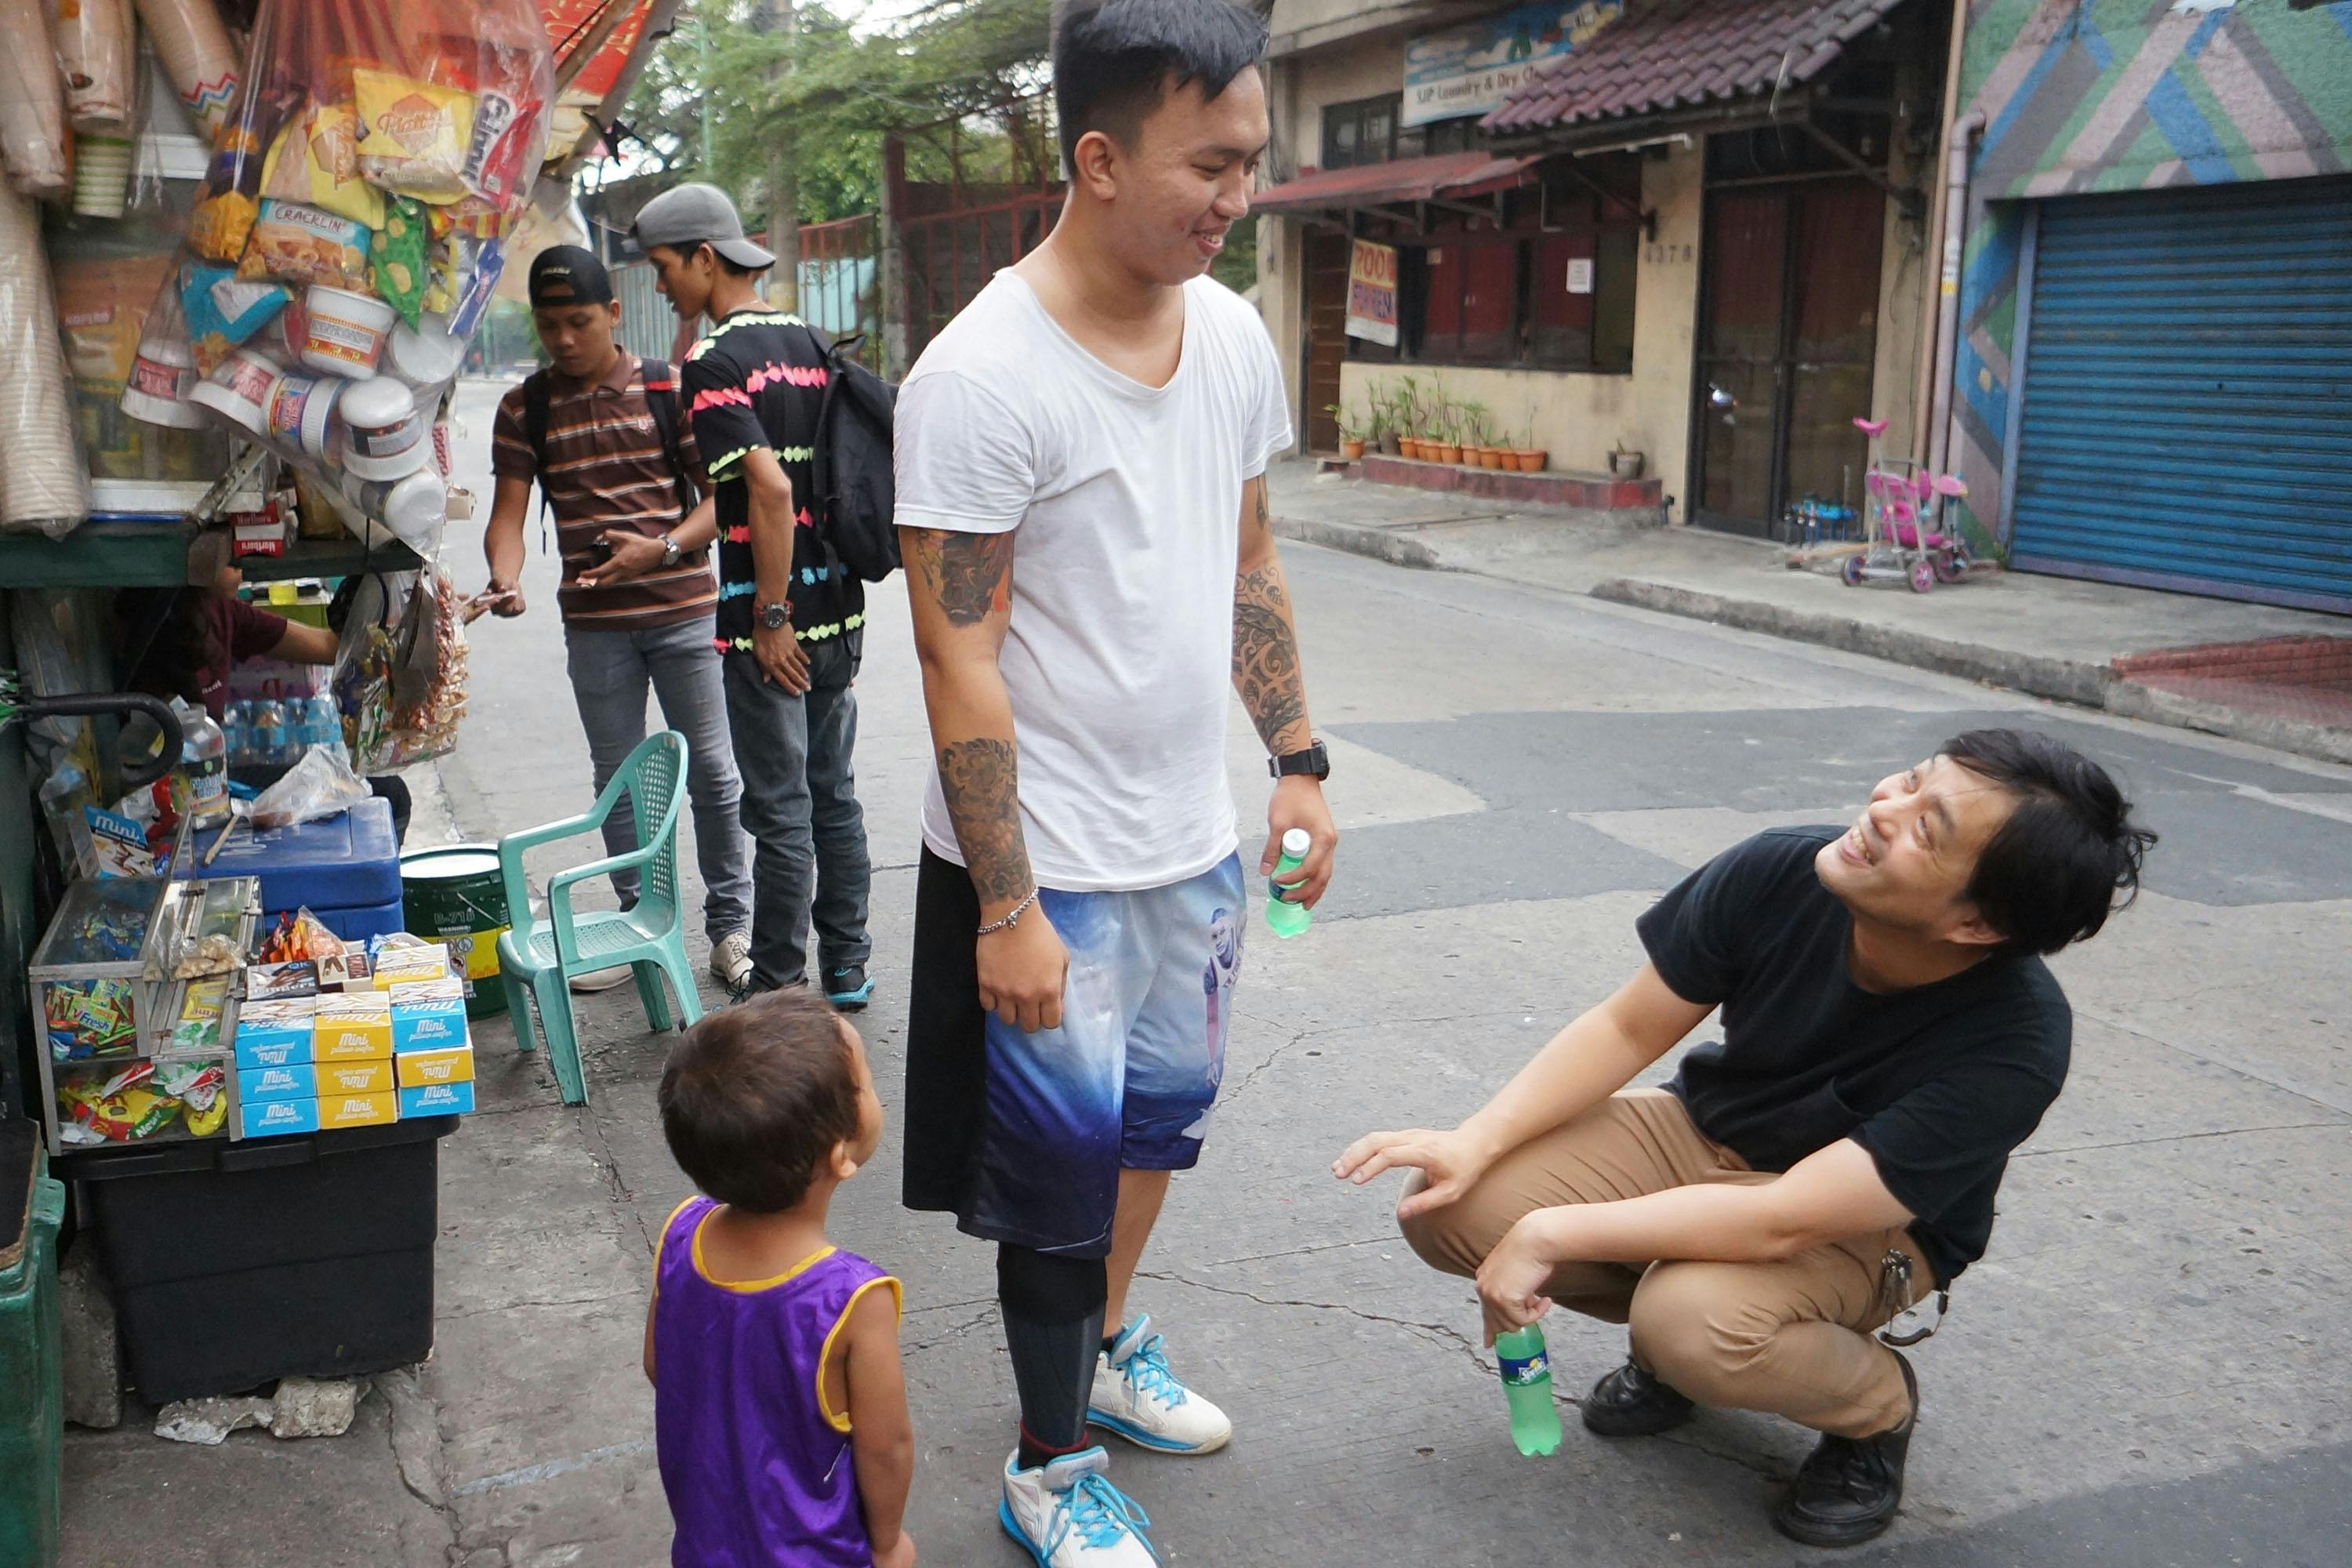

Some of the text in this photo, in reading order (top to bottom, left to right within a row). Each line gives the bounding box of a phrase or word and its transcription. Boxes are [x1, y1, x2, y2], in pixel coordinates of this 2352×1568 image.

[417, 1018, 446, 1033] Mini
[339, 1033, 368, 1047] Mini
[257, 1050, 287, 1065] Mini
[263, 1069, 292, 1084] Mini
[422, 1065, 451, 1079] Mini
[340, 1076, 369, 1089] Mini
[424, 1084, 453, 1099] Mini
[266, 1103, 296, 1118] Mini
[343, 1098, 372, 1113] Mini
